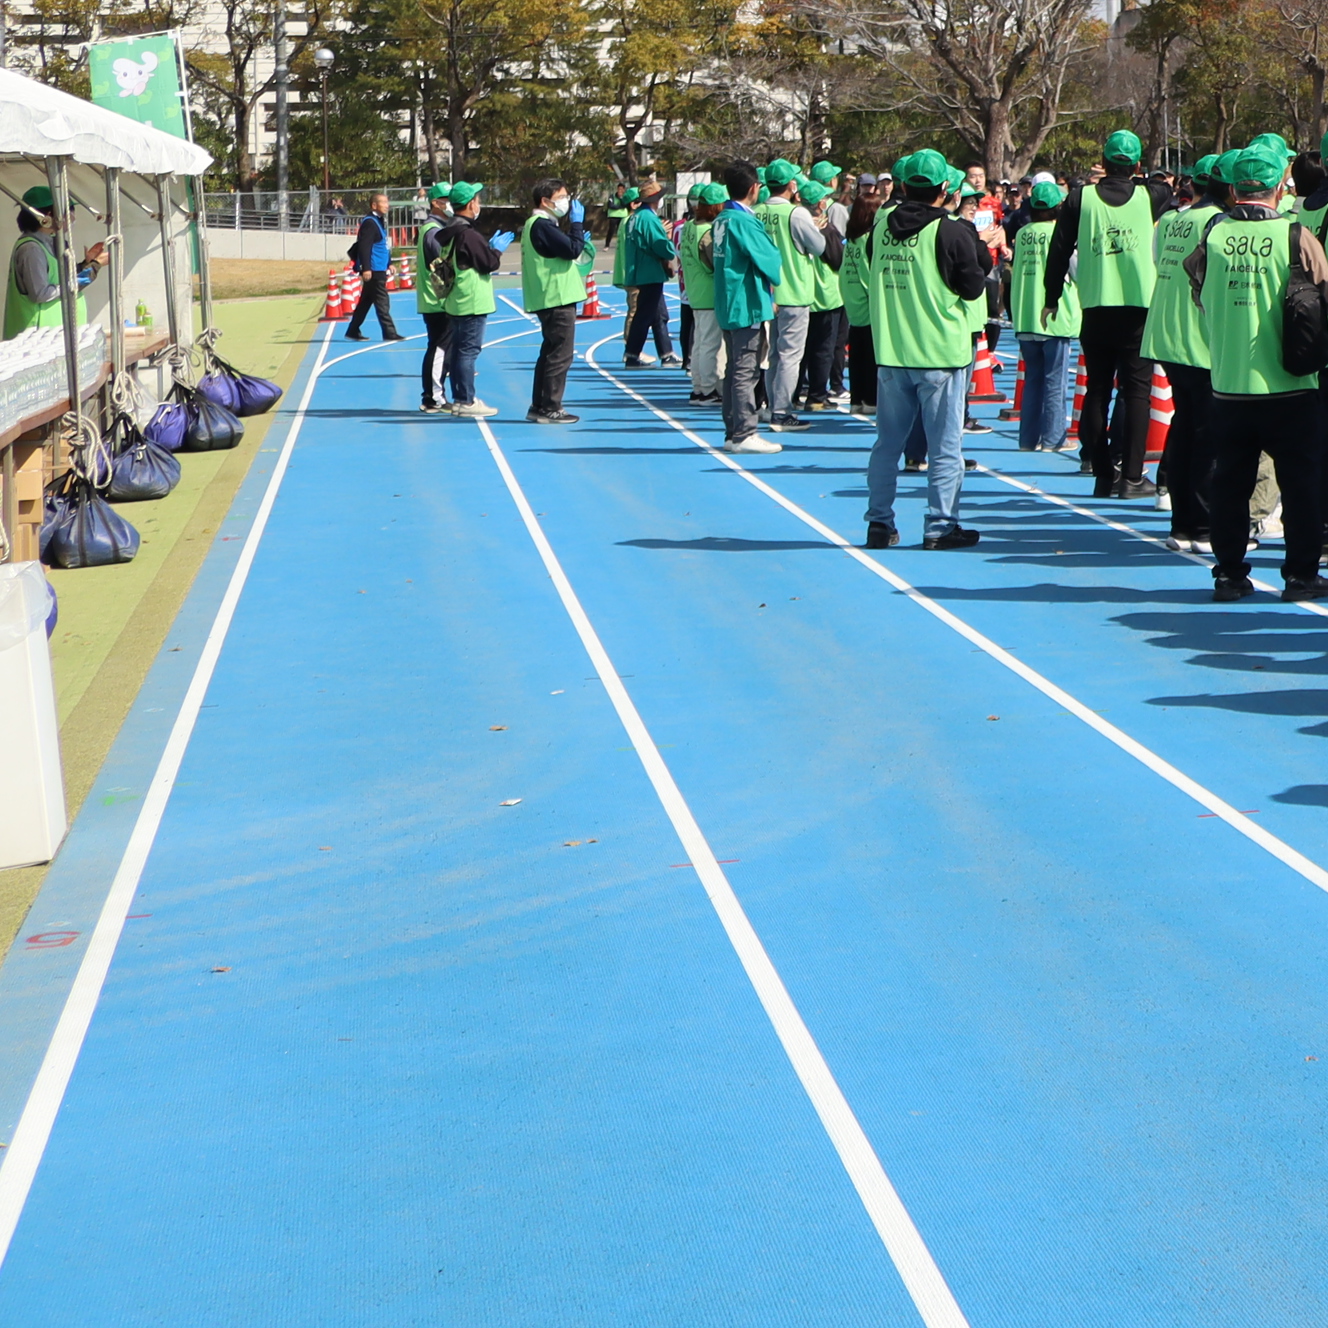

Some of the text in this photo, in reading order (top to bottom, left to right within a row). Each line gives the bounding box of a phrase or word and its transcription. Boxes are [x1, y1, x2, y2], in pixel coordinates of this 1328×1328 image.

[1169, 219, 1193, 239] sala
[1020, 232, 1046, 246] sala
[1223, 236, 1273, 258] sala
[1230, 265, 1268, 275] AICELLO
